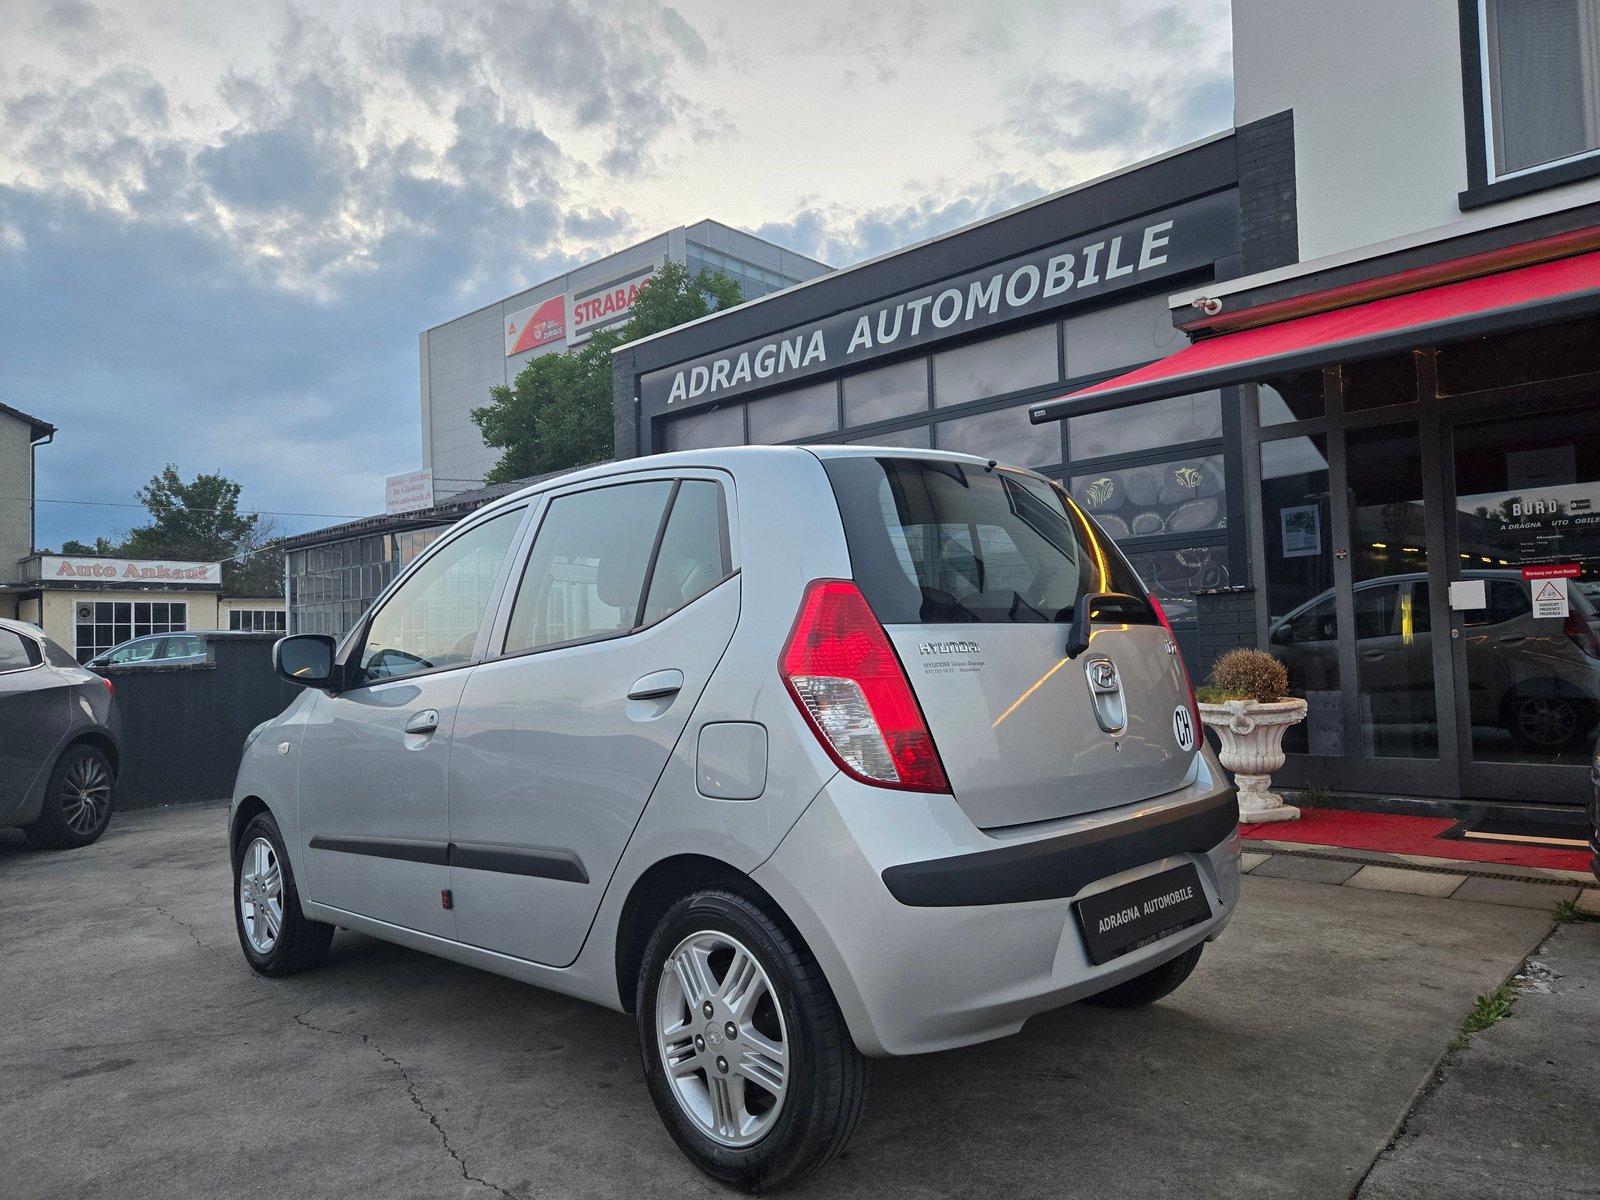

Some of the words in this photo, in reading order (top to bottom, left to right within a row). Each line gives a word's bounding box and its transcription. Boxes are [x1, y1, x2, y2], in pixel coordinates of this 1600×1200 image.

[666, 328, 828, 404] ADRAGNA
[846, 219, 1175, 355] AUTOMOBILE
[56, 560, 117, 578] Auto
[122, 563, 208, 580] Ankauf
[918, 641, 980, 655] HYUNDAI
[1175, 709, 1193, 747] CH
[1098, 905, 1141, 934] ADRAGNA
[1143, 886, 1194, 915] AUTOMOBILE
